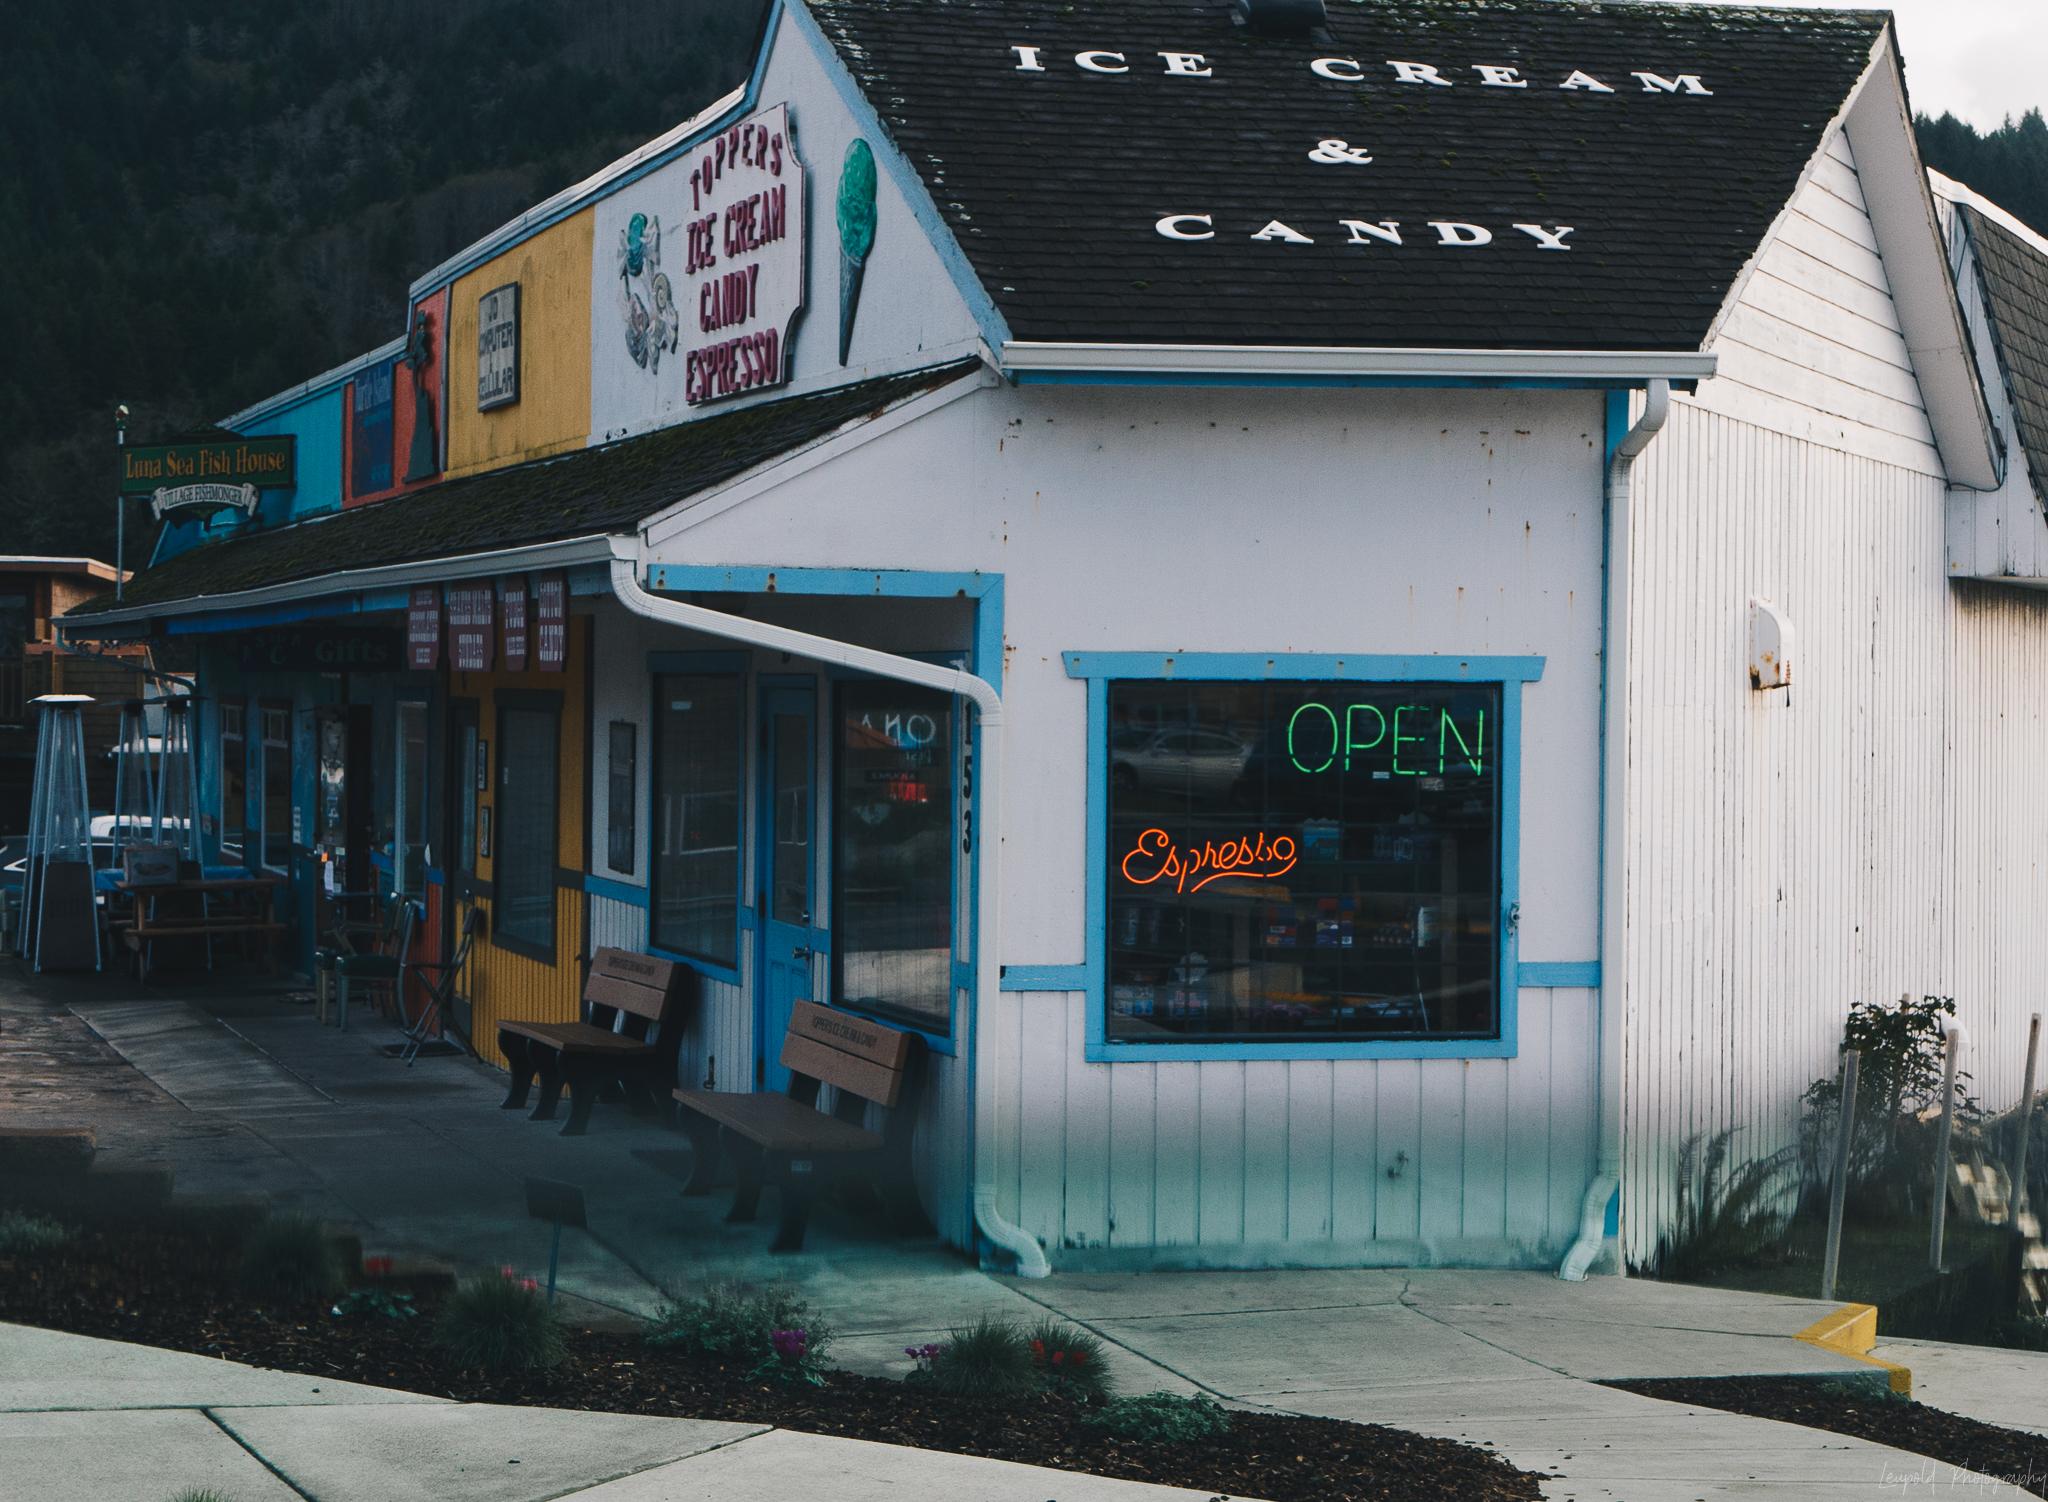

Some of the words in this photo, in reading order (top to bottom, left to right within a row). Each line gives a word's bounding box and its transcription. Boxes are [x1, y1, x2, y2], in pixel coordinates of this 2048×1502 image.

[1010, 45, 1213, 78] ICE
[1309, 57, 1713, 96] CREAM
[689, 123, 783, 211] TOPPERS
[1307, 139, 1373, 166] &
[685, 212, 717, 274] ICE
[723, 183, 786, 258] CREAM
[1155, 214, 1575, 251] CANDY
[700, 263, 759, 333] CANDY
[685, 327, 778, 402] ESPRESSO
[126, 453, 162, 479] Luna
[166, 451, 195, 477] Sea
[200, 449, 231, 476] Fish
[236, 446, 286, 474] House
[163, 485, 194, 507] VILLAGE
[195, 484, 243, 503] FISHMONGER
[315, 638, 389, 664] Gifts
[1287, 702, 1484, 777] OPEN
[1122, 828, 1297, 894] Espresso
